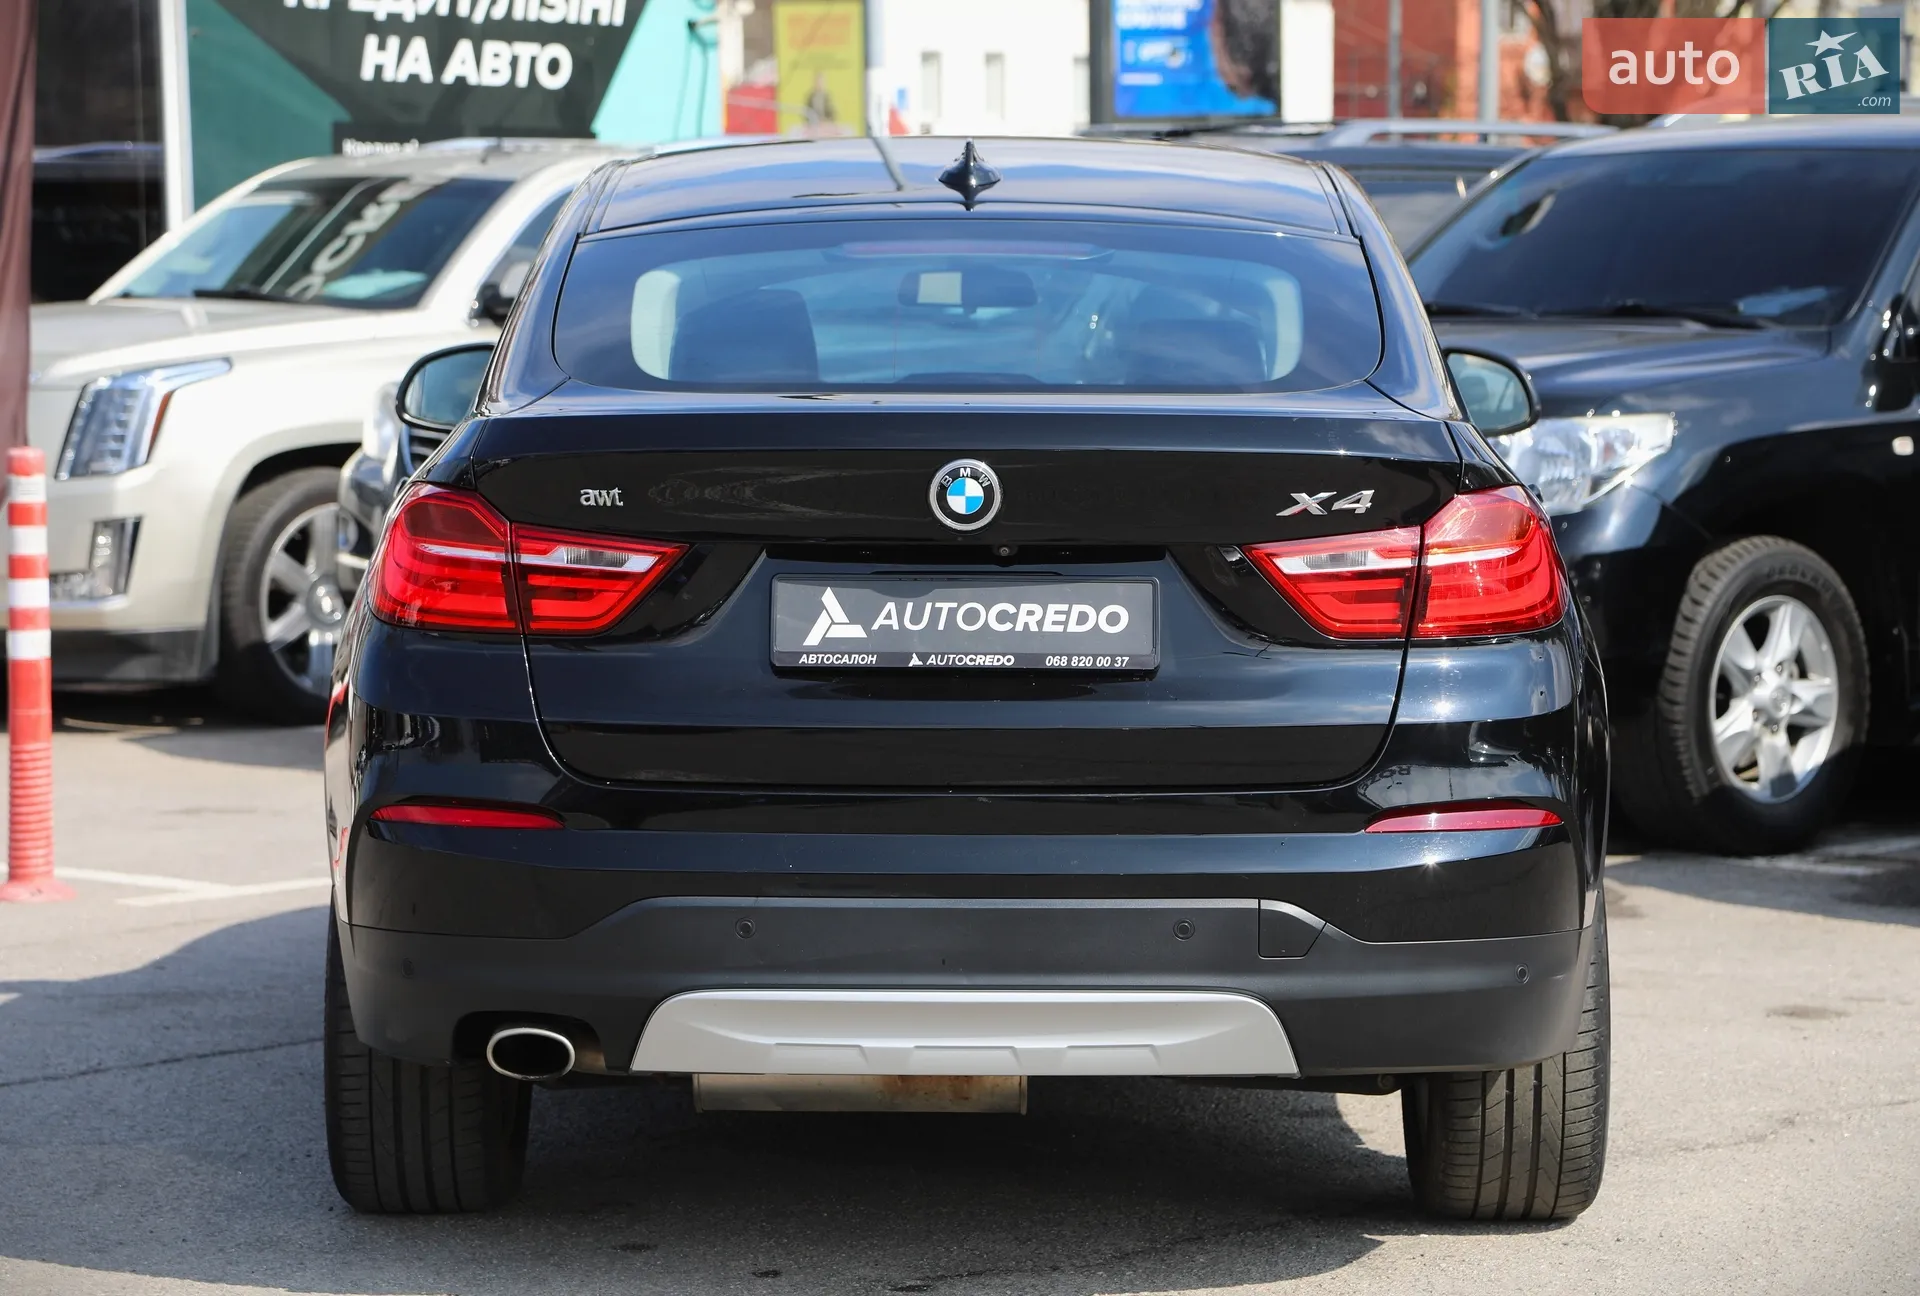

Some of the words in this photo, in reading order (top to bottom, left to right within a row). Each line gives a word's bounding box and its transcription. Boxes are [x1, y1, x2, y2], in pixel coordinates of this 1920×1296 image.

[360, 34, 433, 83] НА
[440, 38, 573, 90] АВТО
[941, 467, 991, 488] BMW
[1276, 489, 1375, 516] X4
[871, 601, 1130, 634] AUTOCREDO
[799, 653, 878, 665] АВТОСАЛОН
[926, 654, 1015, 667] AUTOCREDO
[1045, 655, 1068, 667] 068
[1070, 656, 1094, 667] 820
[1096, 656, 1112, 667] 00
[1114, 656, 1130, 668] 37
